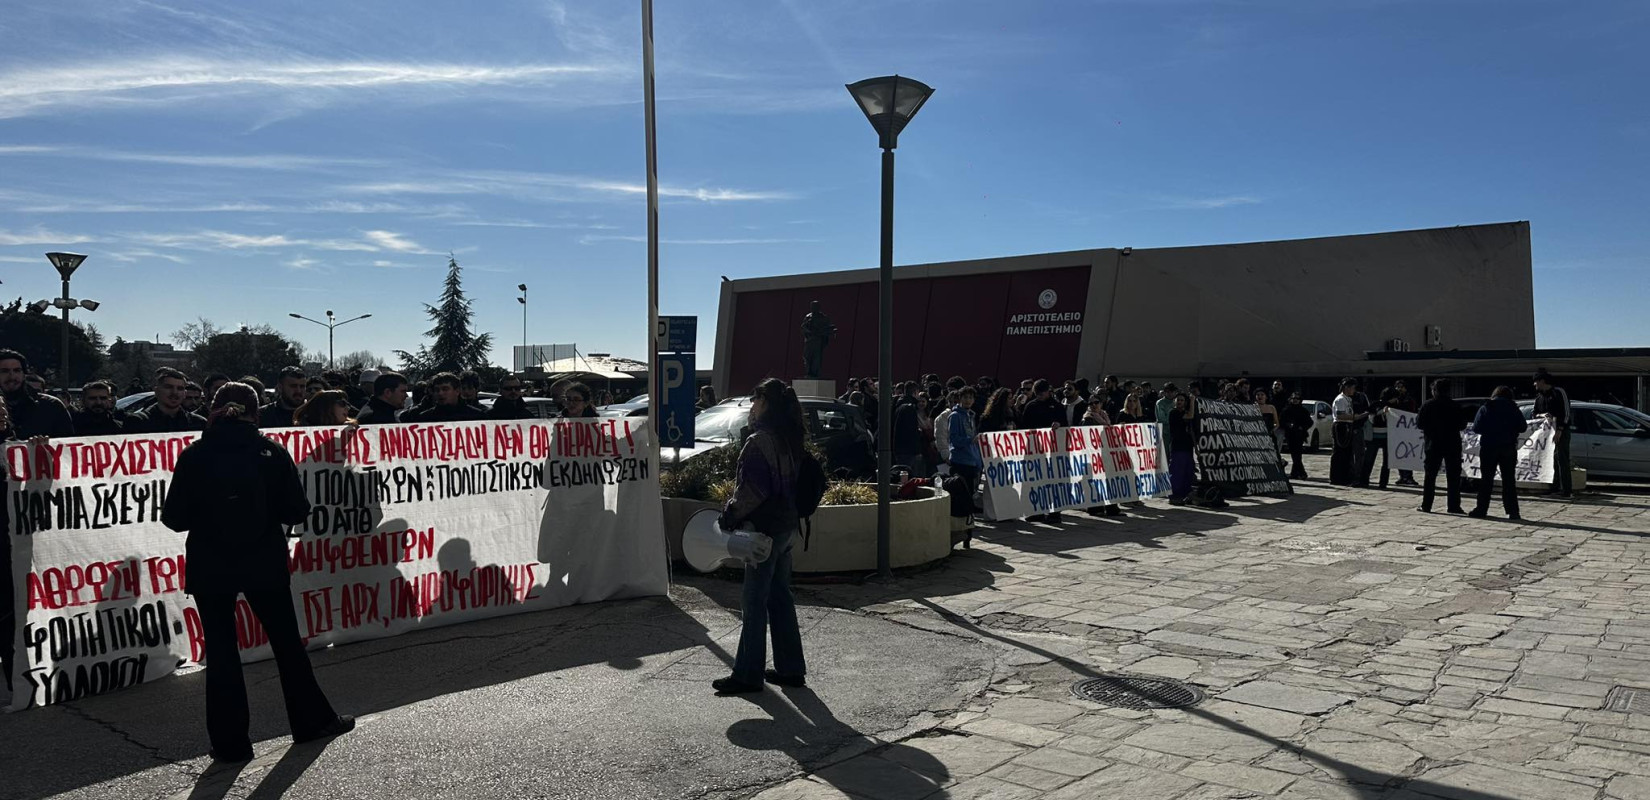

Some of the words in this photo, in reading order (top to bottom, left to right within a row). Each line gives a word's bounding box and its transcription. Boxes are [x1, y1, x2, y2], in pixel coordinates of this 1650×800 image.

[1006, 325, 1082, 335] ΠΑΝΕΠΙΣΤΗΜΙΟ
[1010, 312, 1081, 323] ΑΡΙΣΤΟΤΕΛΕΙΟ
[662, 360, 684, 405] P
[7, 446, 31, 481] Ο
[379, 424, 488, 462] ΑΝΑΣΤΑΣΙΑΔΗ
[494, 423, 523, 460] ΔΕΝ
[530, 424, 550, 460] ΘΑ
[554, 419, 621, 458] ΠΕΡΑΣΕΙ
[979, 433, 990, 458] Η
[993, 429, 1058, 458] ΚΑΤΑΣΤΟΛΗ
[1065, 427, 1086, 452] ΔΕΝ
[1089, 427, 1103, 450] ΘΑ
[1104, 424, 1144, 449] ΠΕΡΑΣΕΙ
[1200, 452, 1216, 467] ΤΟ
[987, 458, 1042, 488] ΦΟΙΤΗΤΩΝ
[1045, 457, 1054, 479] Η
[1056, 454, 1088, 479] ΠΑΛΗ
[1091, 453, 1105, 475] ΘΑ
[1109, 450, 1132, 472] ΤΗΝ
[1205, 468, 1227, 481] ΤΗΝ
[13, 485, 90, 535] ΚΑΜΙΑ
[91, 479, 166, 530] ΣΚΕΨΗ
[315, 466, 423, 508] ΠΟΛΙΤΙΚΩΝ
[436, 460, 544, 499] ΠΟΛΙΤΙΣΤΙΚΩΝ
[550, 456, 649, 488] ΕΚΔΗΛΩΣΕΩΝ
[1028, 481, 1085, 512] ΦΟΙΤΗΤΙΚΟΙ
[1088, 475, 1131, 503] ΣΥΛΛΟΓΟΙ
[332, 508, 373, 536] ΑΠΘ
[26, 560, 141, 610] ΑΘΩΩΣΗ
[23, 600, 171, 664] ΦΟΙΤΗΤΙΚΟΙ
[390, 563, 540, 620] ΠΛΗΡΟΦΟΡΙΚΗΣ
